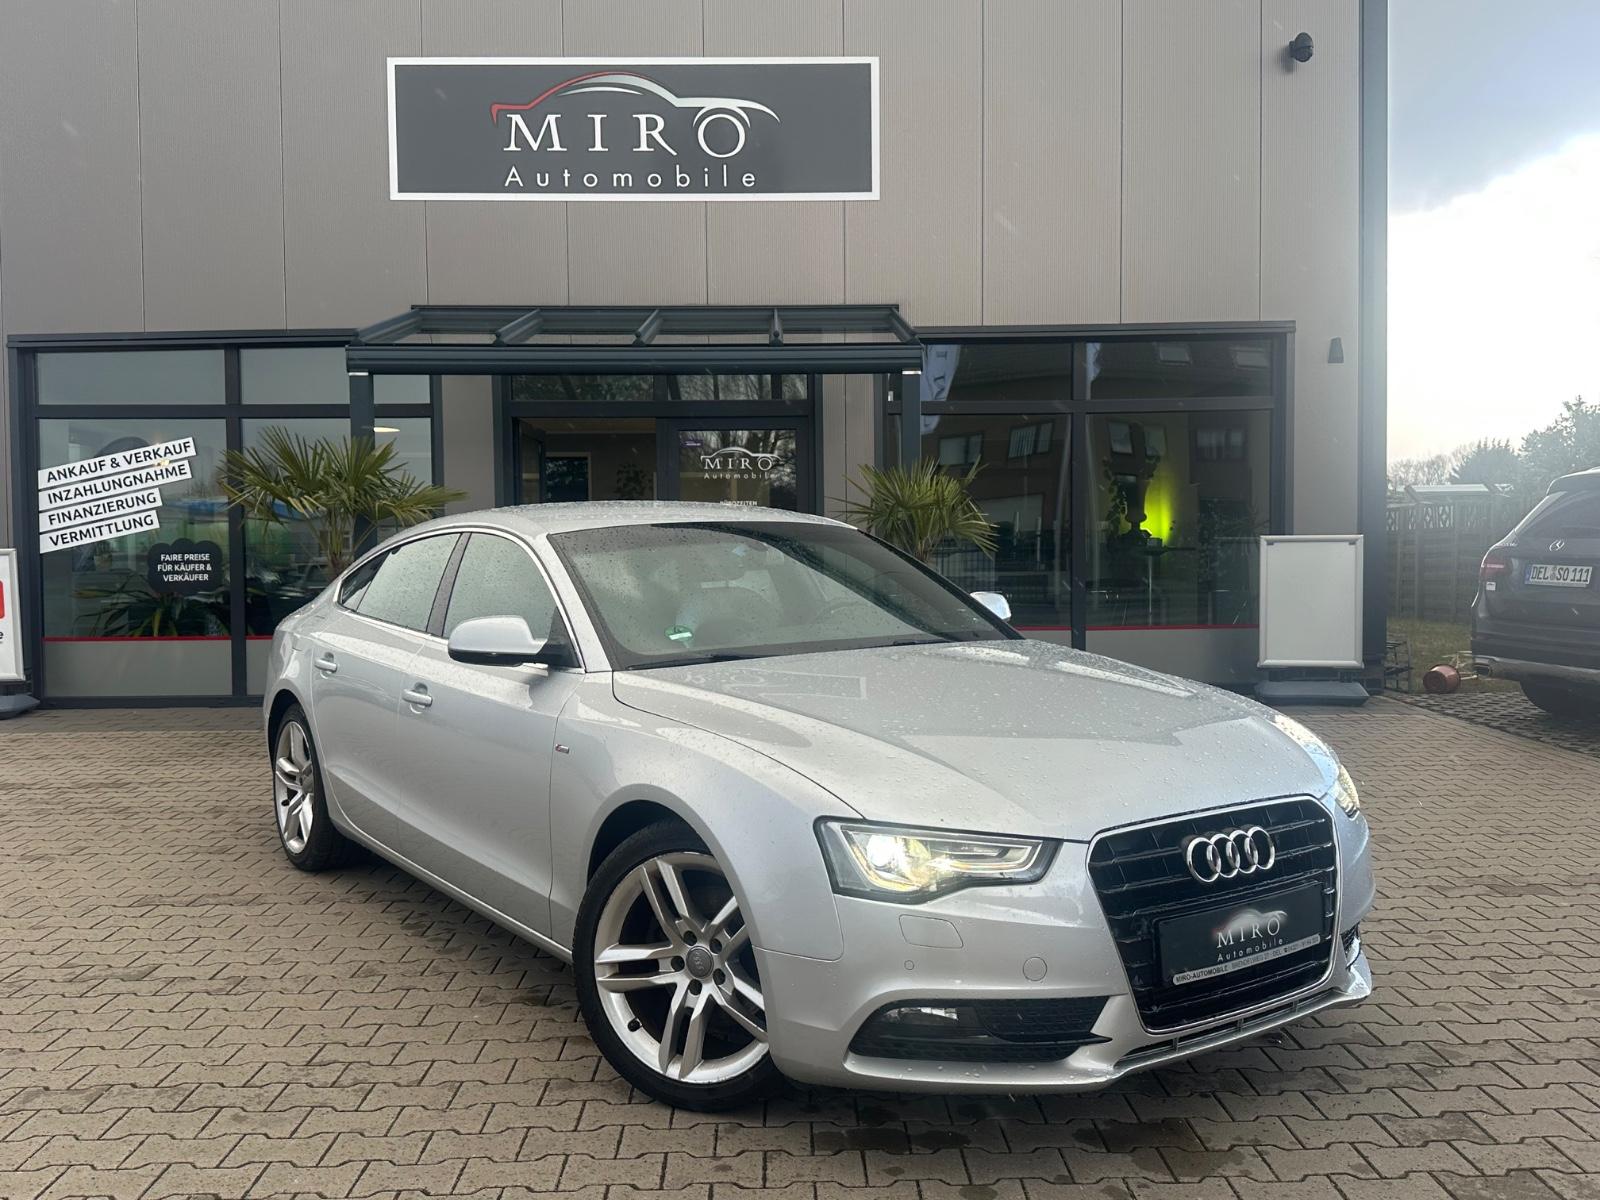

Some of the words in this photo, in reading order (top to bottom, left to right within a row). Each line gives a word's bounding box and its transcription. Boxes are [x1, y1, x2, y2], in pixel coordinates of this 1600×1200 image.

[503, 113, 747, 158] MIRO
[504, 165, 756, 188] Automobile
[47, 459, 106, 483] ANKAUF
[110, 457, 120, 469] &
[123, 441, 191, 465] VERKAUF
[703, 457, 772, 471] MIRO
[48, 464, 187, 504] INZAHLUNGNAHME
[48, 492, 156, 525] FINANZIERUNG
[49, 515, 154, 547] VERMITTLUNG
[157, 562, 173, 571] FÜR
[174, 562, 205, 571] KÄUFER
[206, 563, 212, 571] &
[160, 553, 183, 561] FAIRE
[184, 553, 210, 561] PREISE
[163, 572, 209, 582] VERKÄUFER
[1531, 566, 1549, 580] DEL
[1570, 568, 1590, 582] 111
[1216, 917, 1280, 948] MIRO
[1217, 938, 1283, 962] Automobile
